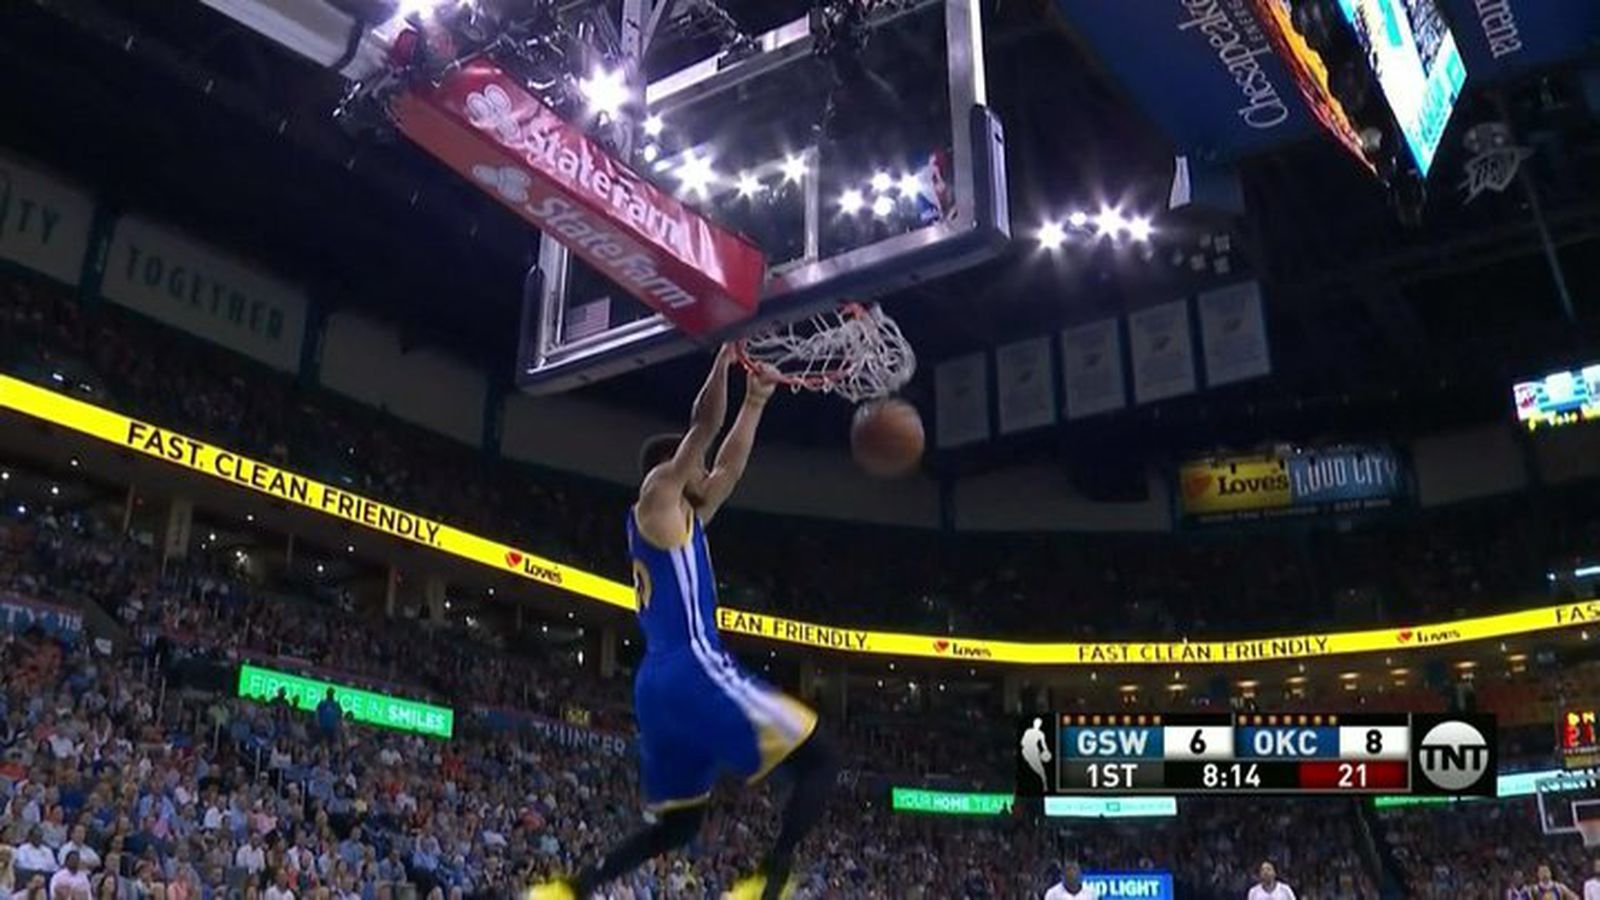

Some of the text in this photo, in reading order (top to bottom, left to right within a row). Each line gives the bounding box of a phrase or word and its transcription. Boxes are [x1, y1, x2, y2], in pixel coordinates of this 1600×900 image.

[1475, 0, 1522, 59] rena
[127, 421, 442, 547] FAST. CLEAN. FRIENDLY.
[772, 618, 872, 651] FRIENDLY.
[305, 687, 363, 714] PCE
[388, 704, 445, 730] SMILES
[1109, 879, 1160, 897] LIGHT
